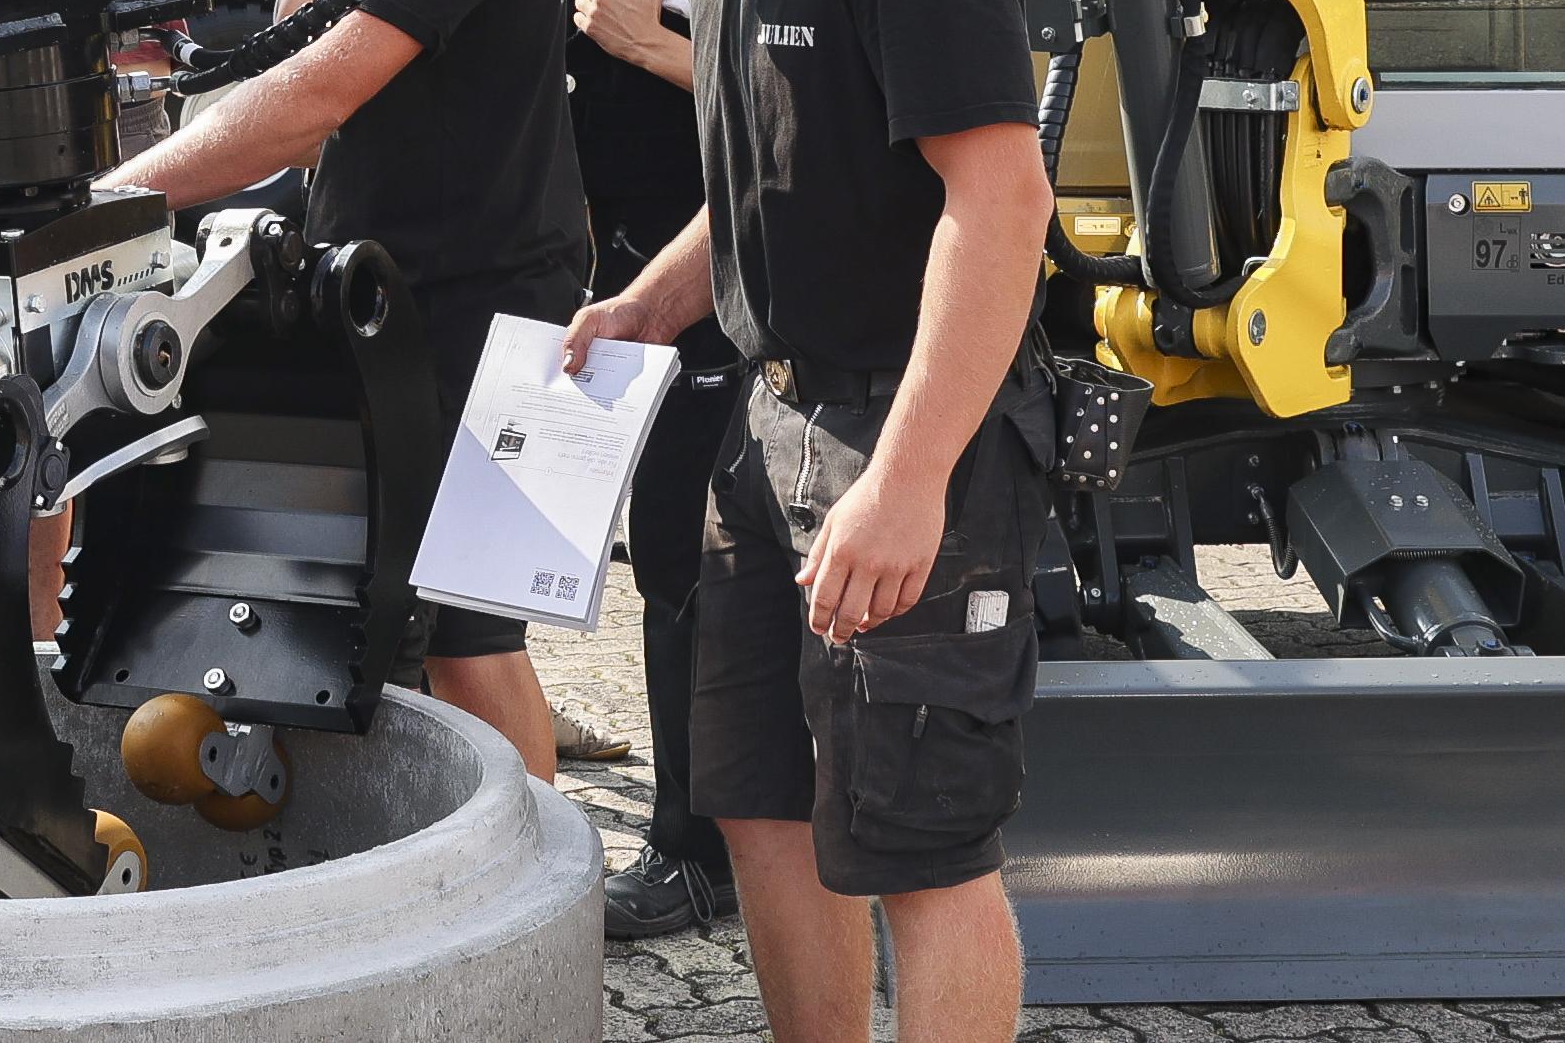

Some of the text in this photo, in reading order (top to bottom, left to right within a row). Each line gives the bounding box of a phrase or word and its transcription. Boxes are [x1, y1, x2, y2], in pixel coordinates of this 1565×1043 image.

[757, 23, 815, 47] JULIEN
[1476, 239, 1508, 269] 97
[64, 259, 115, 305] DMS
